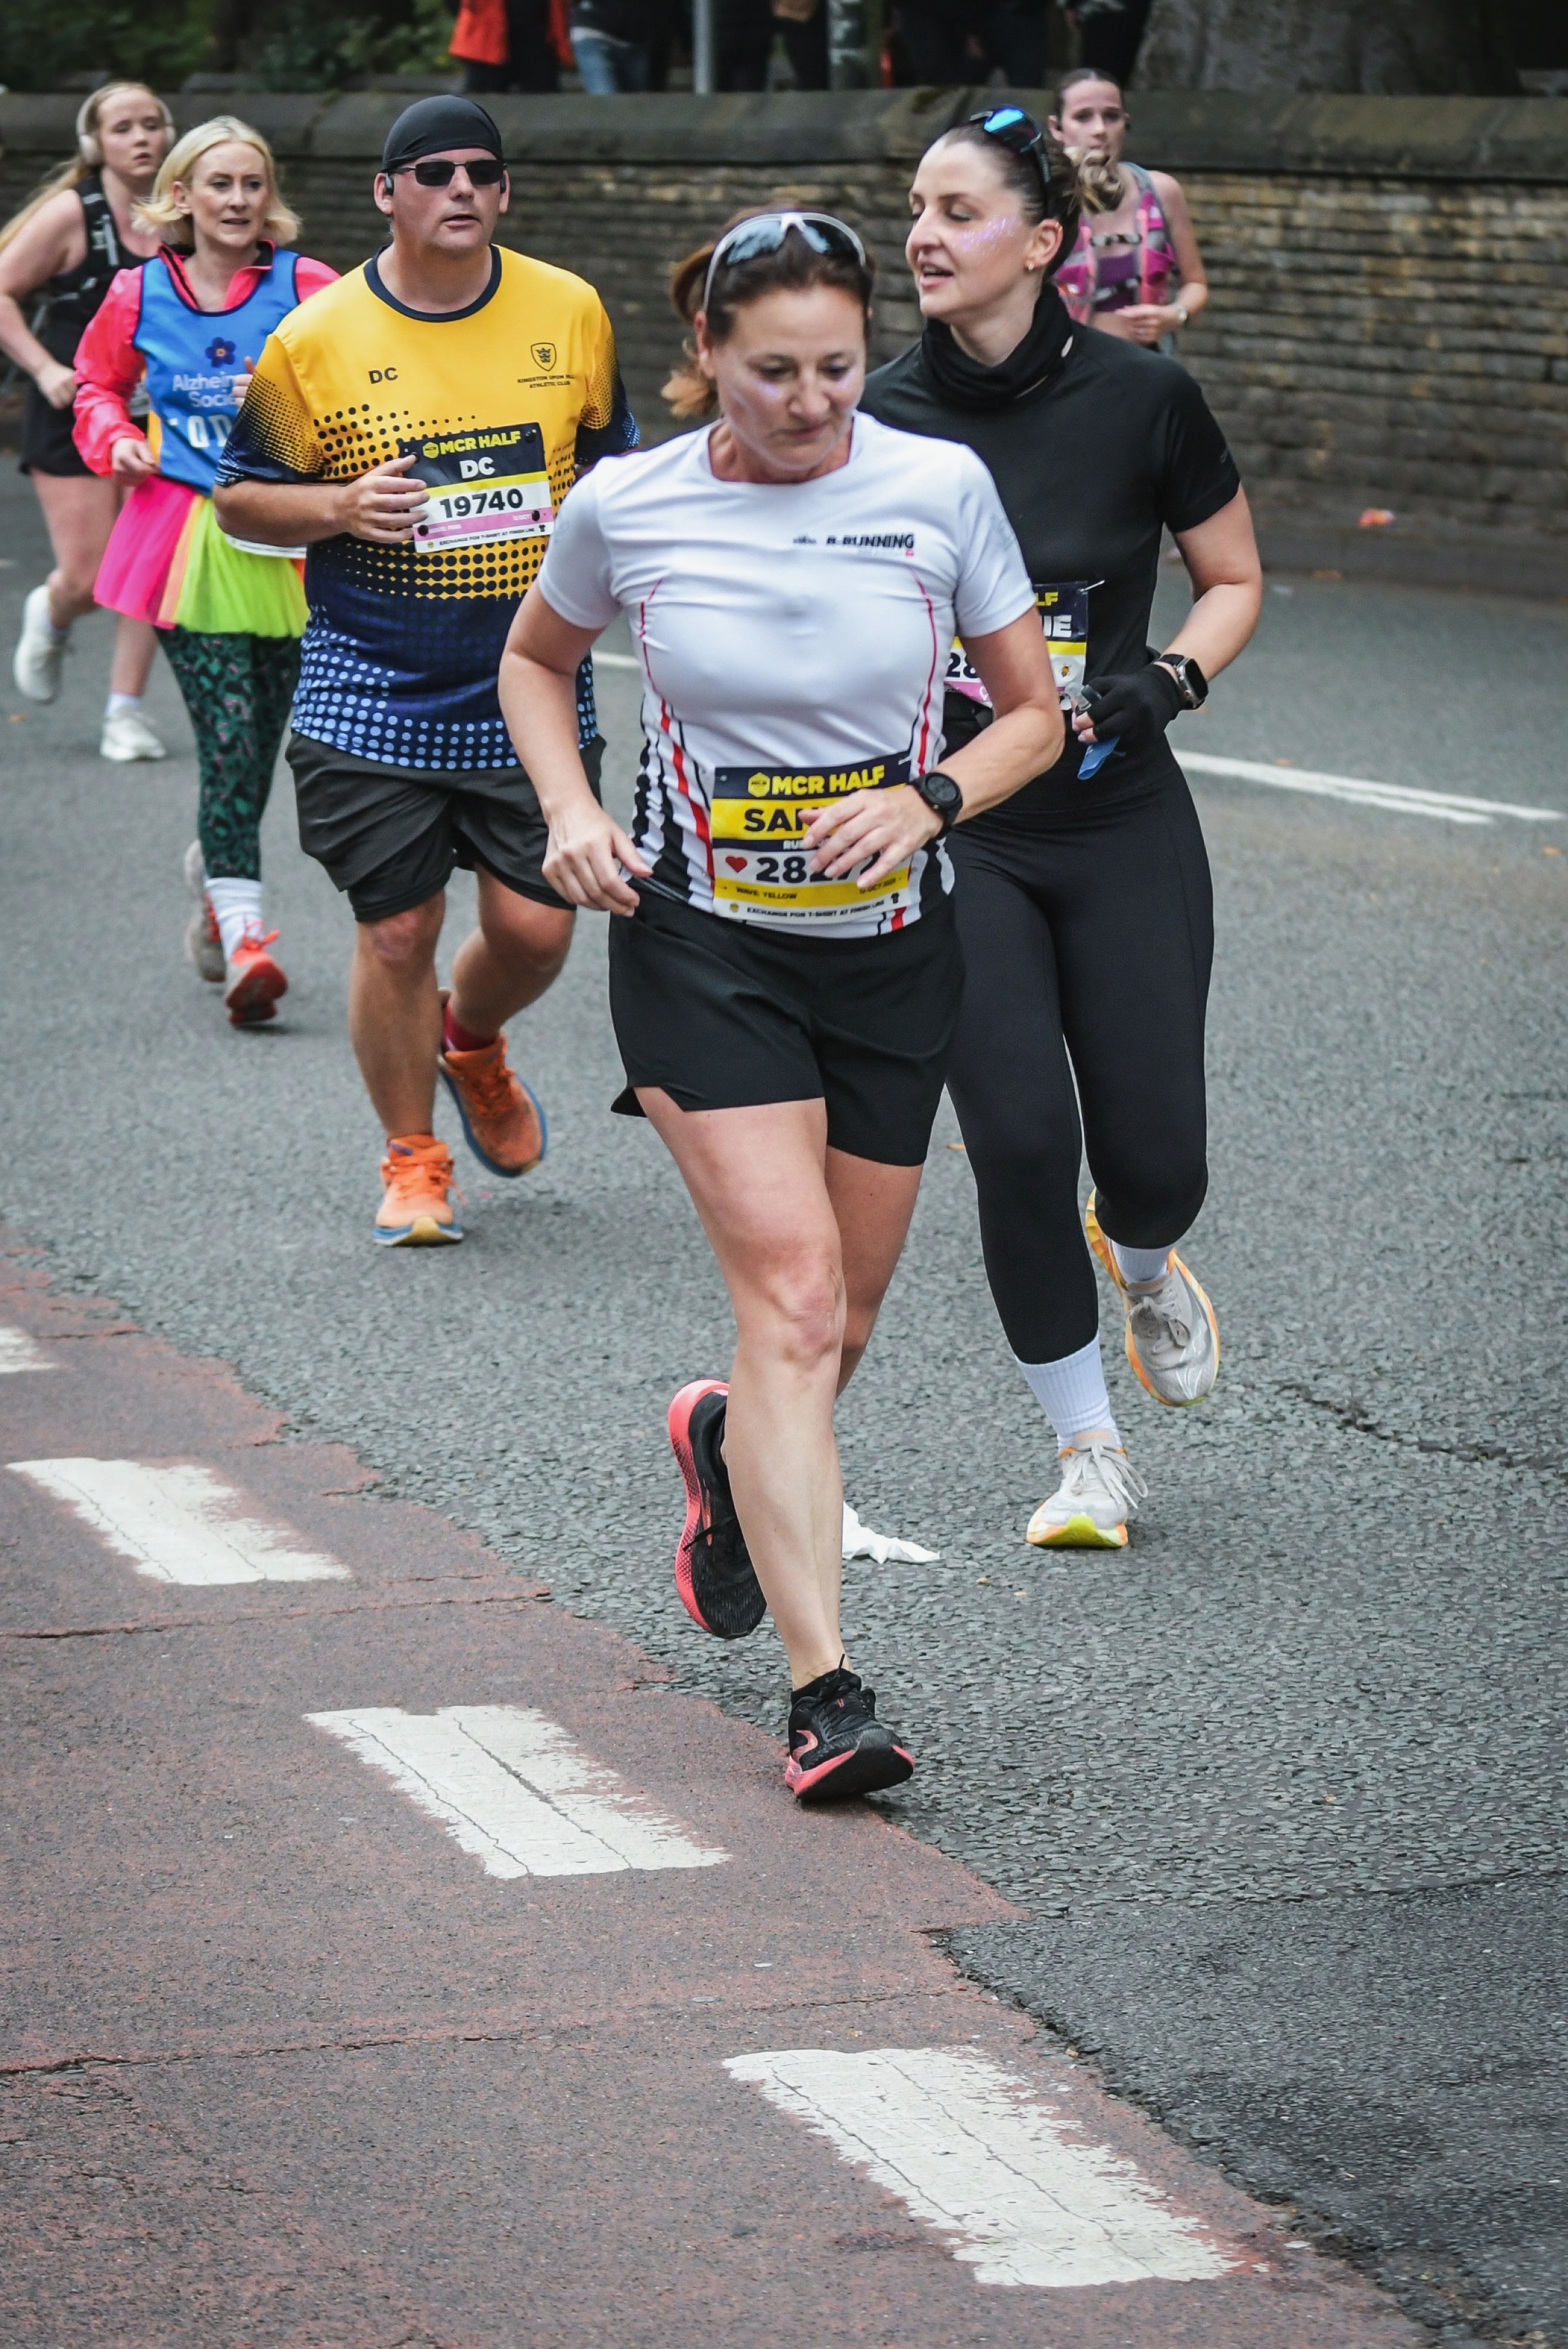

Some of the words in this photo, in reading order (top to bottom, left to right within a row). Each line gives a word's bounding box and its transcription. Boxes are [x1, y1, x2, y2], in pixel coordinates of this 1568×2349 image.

[368, 367, 399, 384] DC
[440, 438, 477, 454] MCR
[479, 431, 521, 448] HALF
[459, 457, 496, 479] DC
[439, 488, 523, 519] 19740
[1035, 591, 1059, 606] LF
[1041, 614, 1072, 638] IE
[772, 775, 825, 796] MCR
[829, 765, 885, 793] HALF
[743, 807, 820, 832] SA
